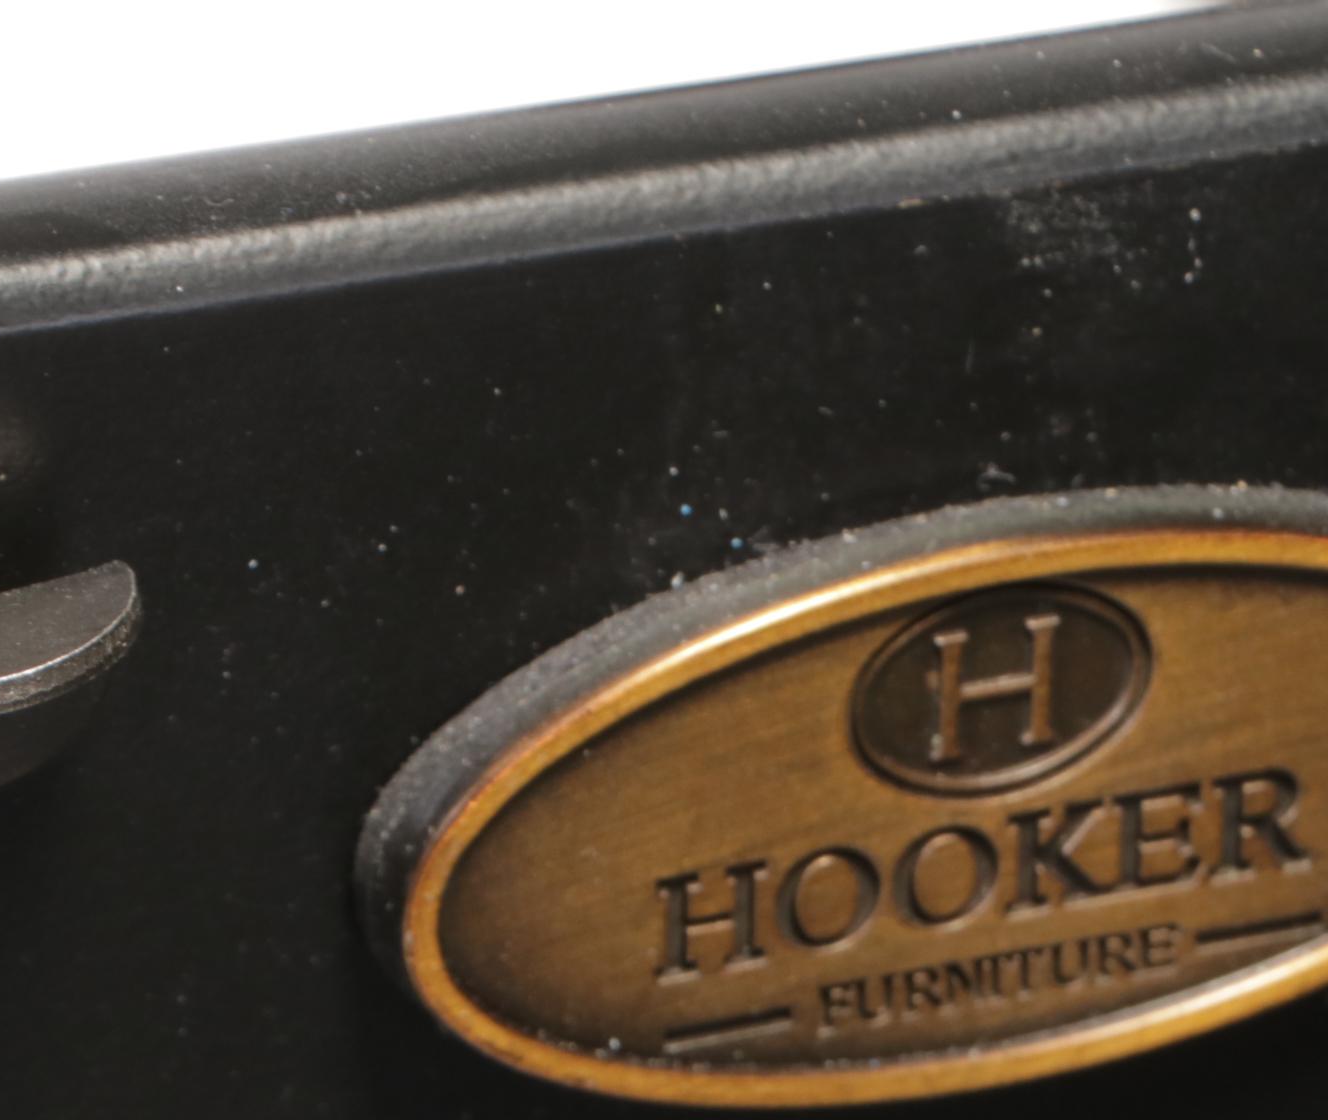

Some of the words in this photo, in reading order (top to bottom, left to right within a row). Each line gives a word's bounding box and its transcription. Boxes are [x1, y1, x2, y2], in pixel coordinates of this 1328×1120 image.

[929, 614, 1060, 763] H
[654, 766, 1312, 984] HOOKER
[816, 922, 1183, 1034] FURNITURE
